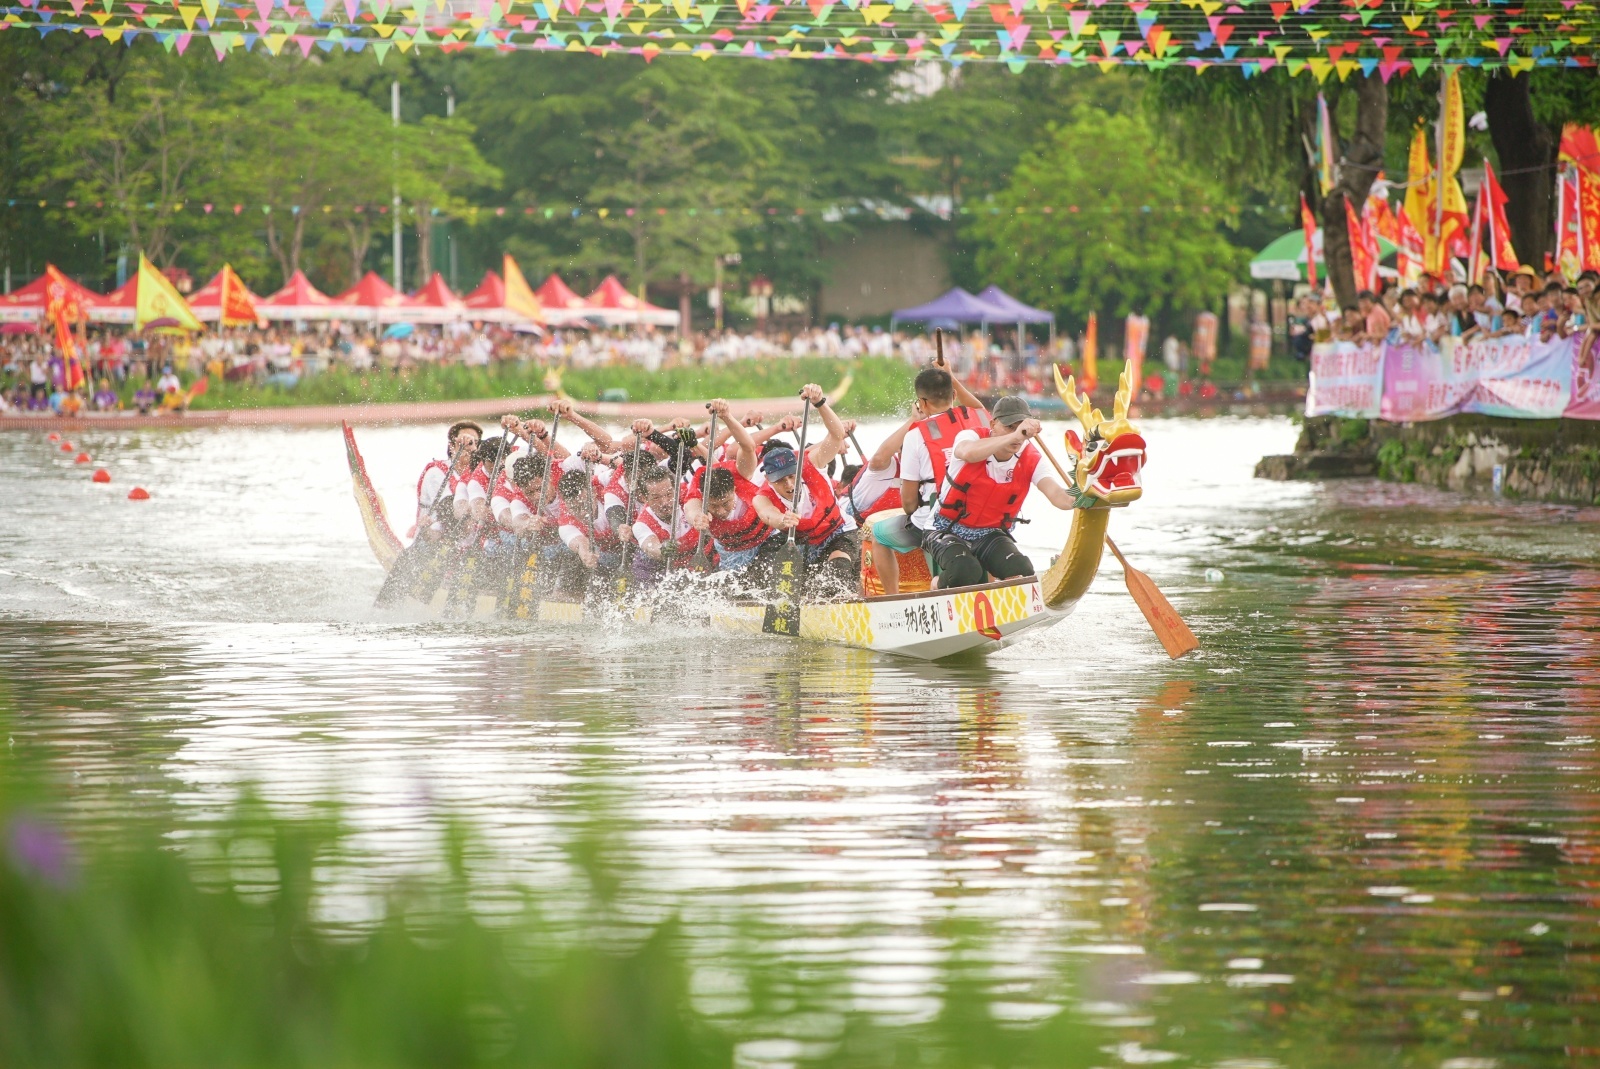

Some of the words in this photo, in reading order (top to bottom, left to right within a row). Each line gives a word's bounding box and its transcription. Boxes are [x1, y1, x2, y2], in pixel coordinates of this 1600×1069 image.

[904, 602, 943, 635] 纳德利
[978, 600, 994, 634] 1
